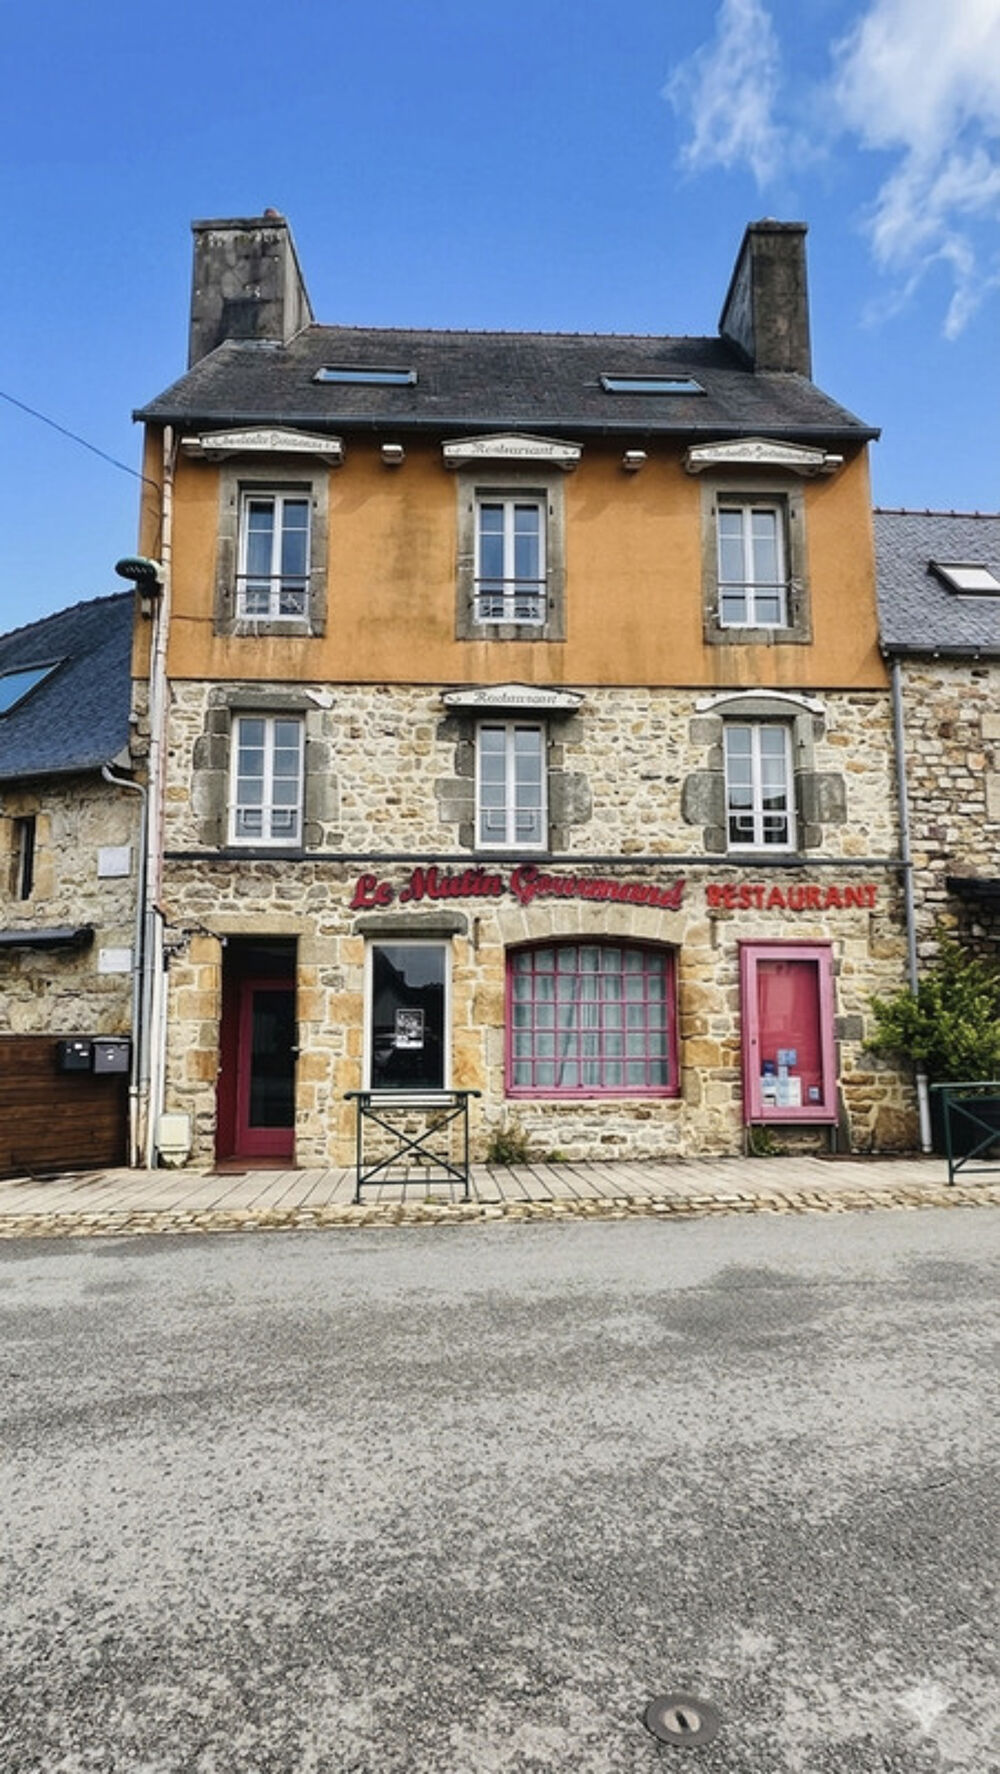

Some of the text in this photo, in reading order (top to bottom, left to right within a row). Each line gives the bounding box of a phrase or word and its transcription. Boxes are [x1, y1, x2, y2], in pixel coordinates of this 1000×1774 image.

[348, 873, 394, 910] Le
[510, 863, 686, 910] Gourmand
[705, 884, 877, 911] RESTAURANT
